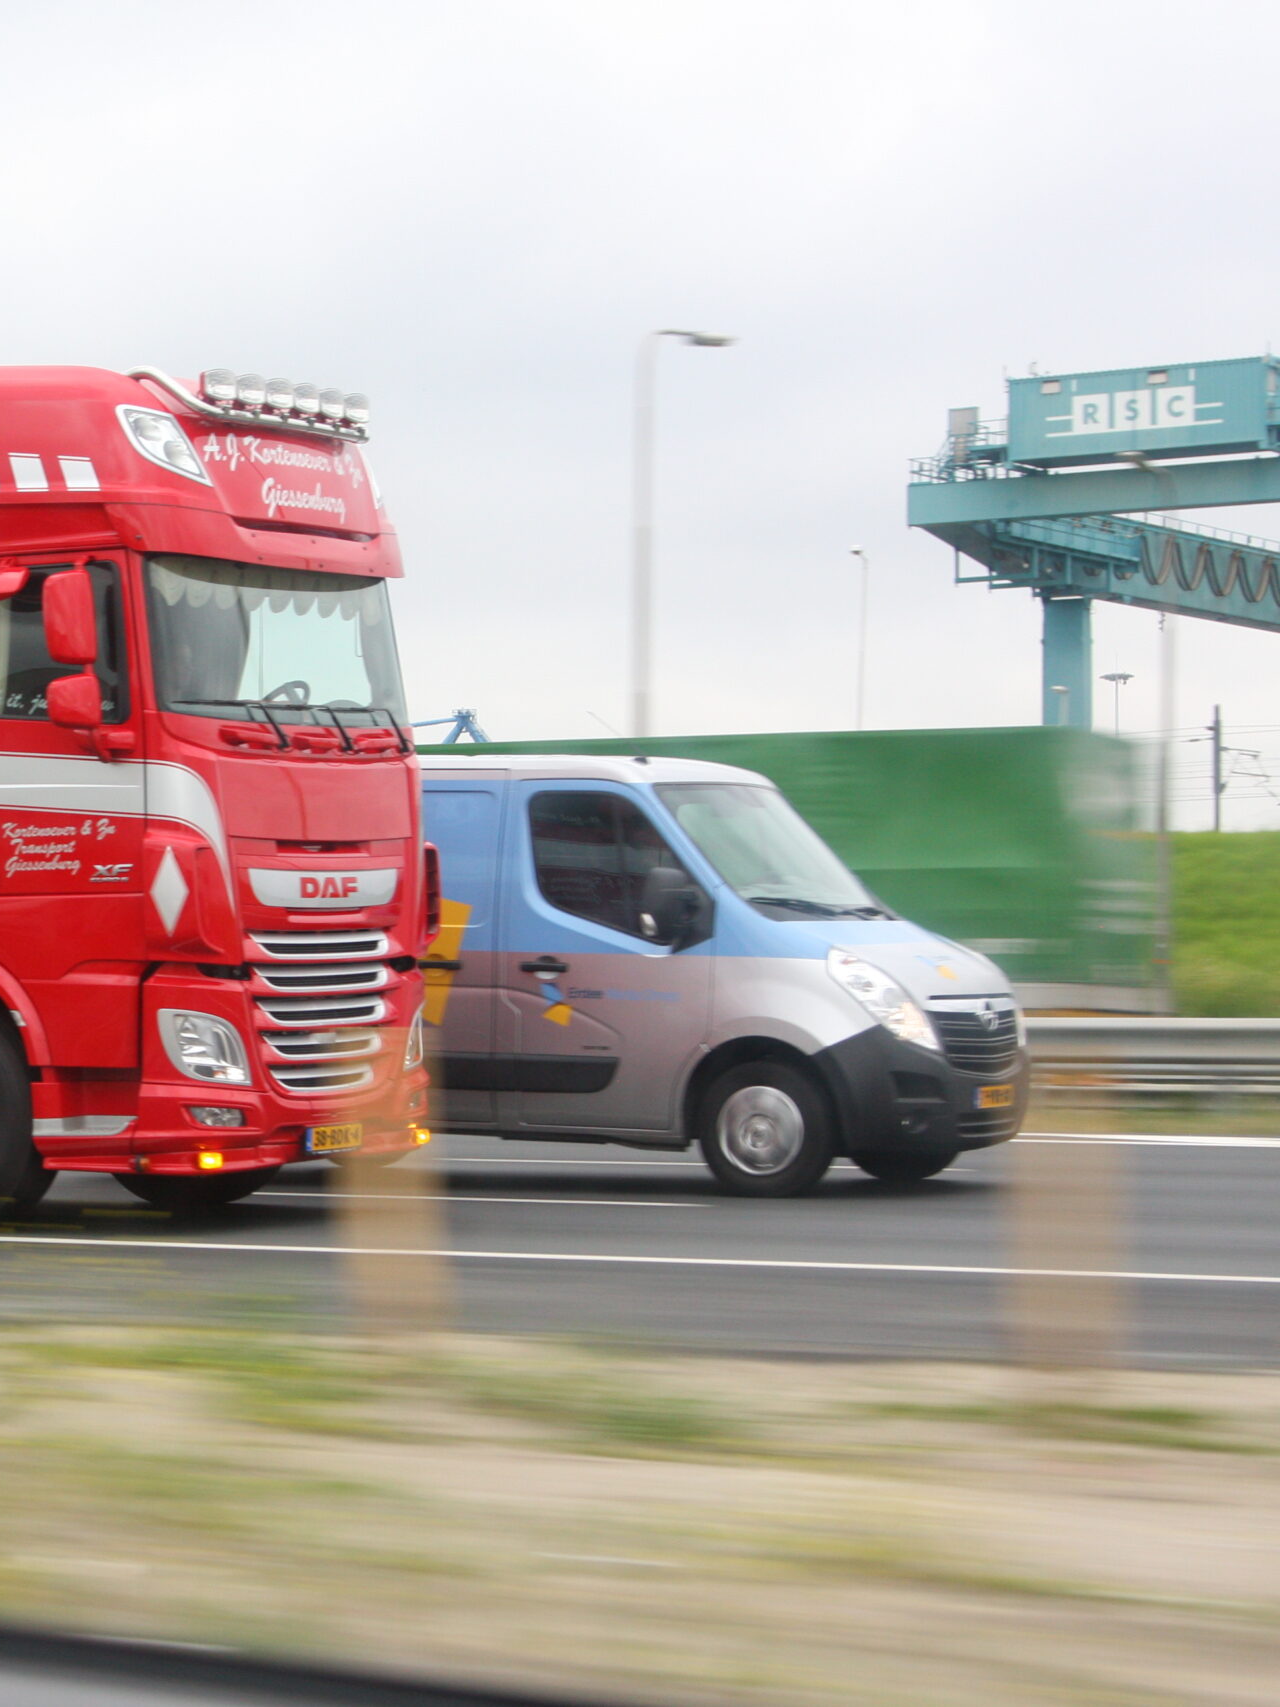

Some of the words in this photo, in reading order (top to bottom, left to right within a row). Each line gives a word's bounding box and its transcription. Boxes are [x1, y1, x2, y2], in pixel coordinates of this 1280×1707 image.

[1082, 395, 1186, 426] RSC
[261, 476, 347, 525] Giessenburg
[9, 838, 77, 857] Transport
[3, 855, 81, 878] Giessenburg
[90, 863, 134, 877] XF
[299, 876, 360, 899] DAF
